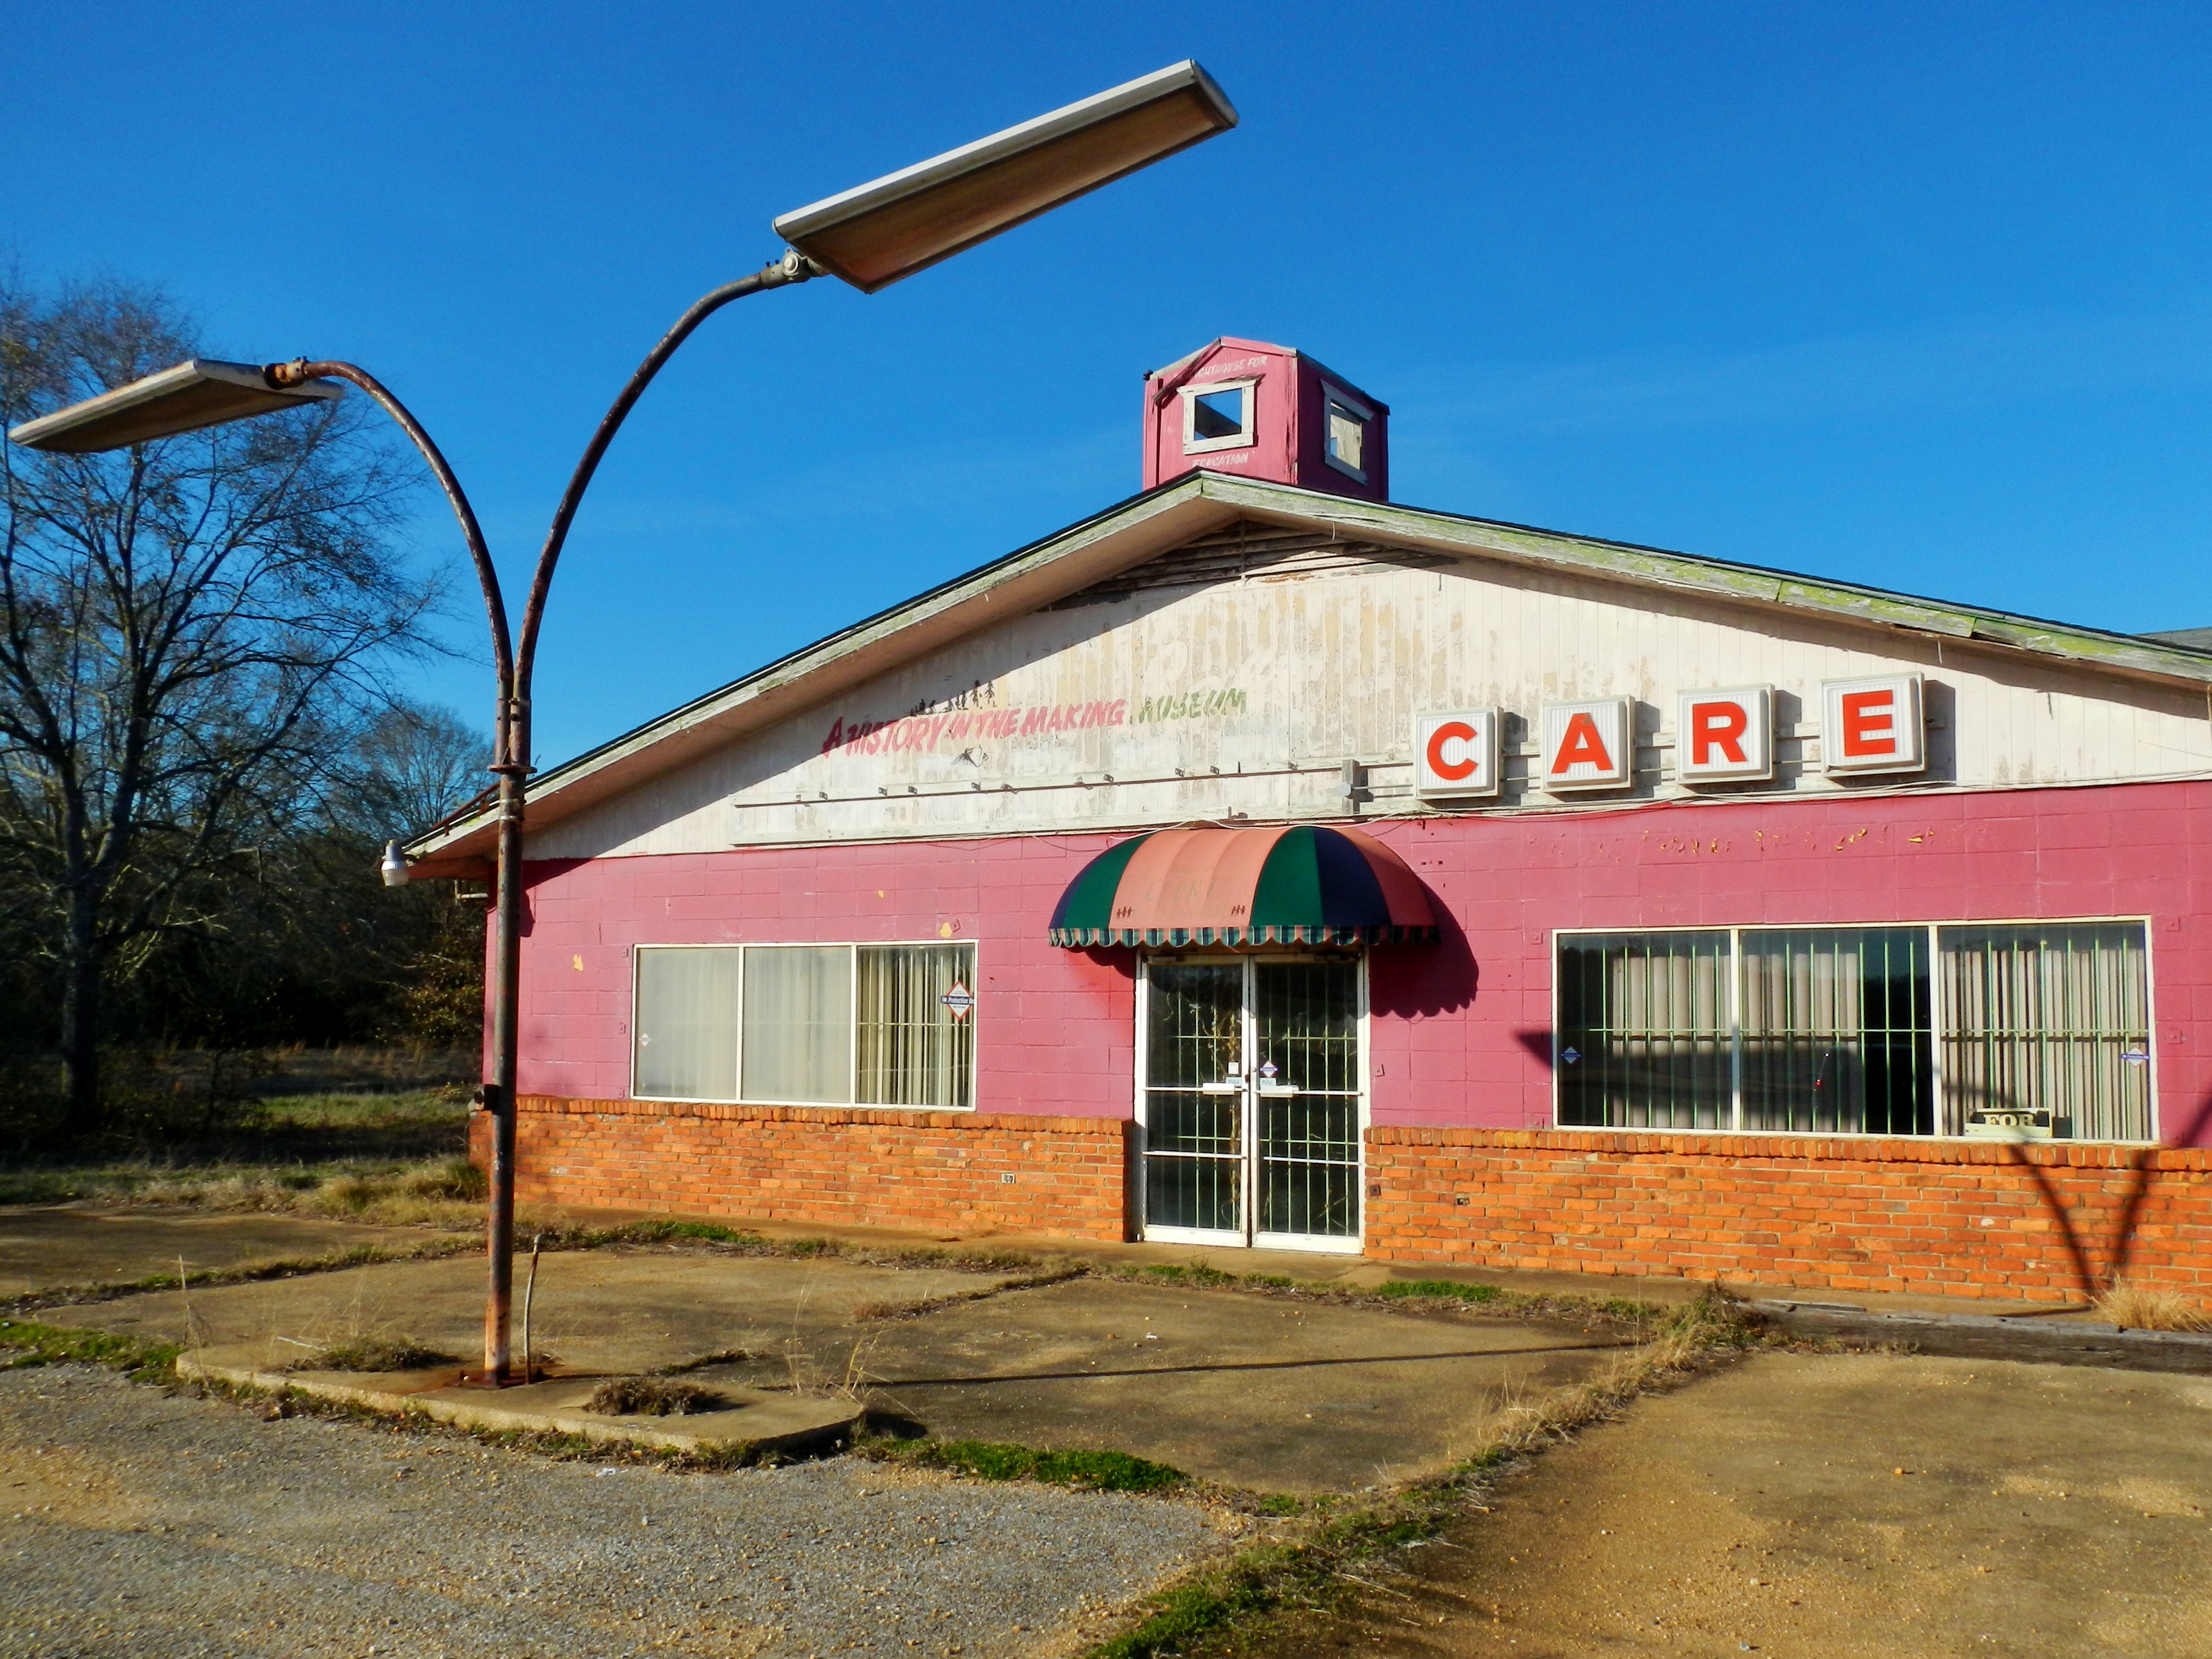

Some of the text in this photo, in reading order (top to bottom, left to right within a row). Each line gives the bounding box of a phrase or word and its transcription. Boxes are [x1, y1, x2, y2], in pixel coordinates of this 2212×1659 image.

[1247, 355, 1268, 369] FOR
[820, 688, 1246, 758] A HISTORY IN THE MAKING MUSEUM
[1426, 689, 1896, 781] CARE
[1983, 1114, 2036, 1126] FOR
